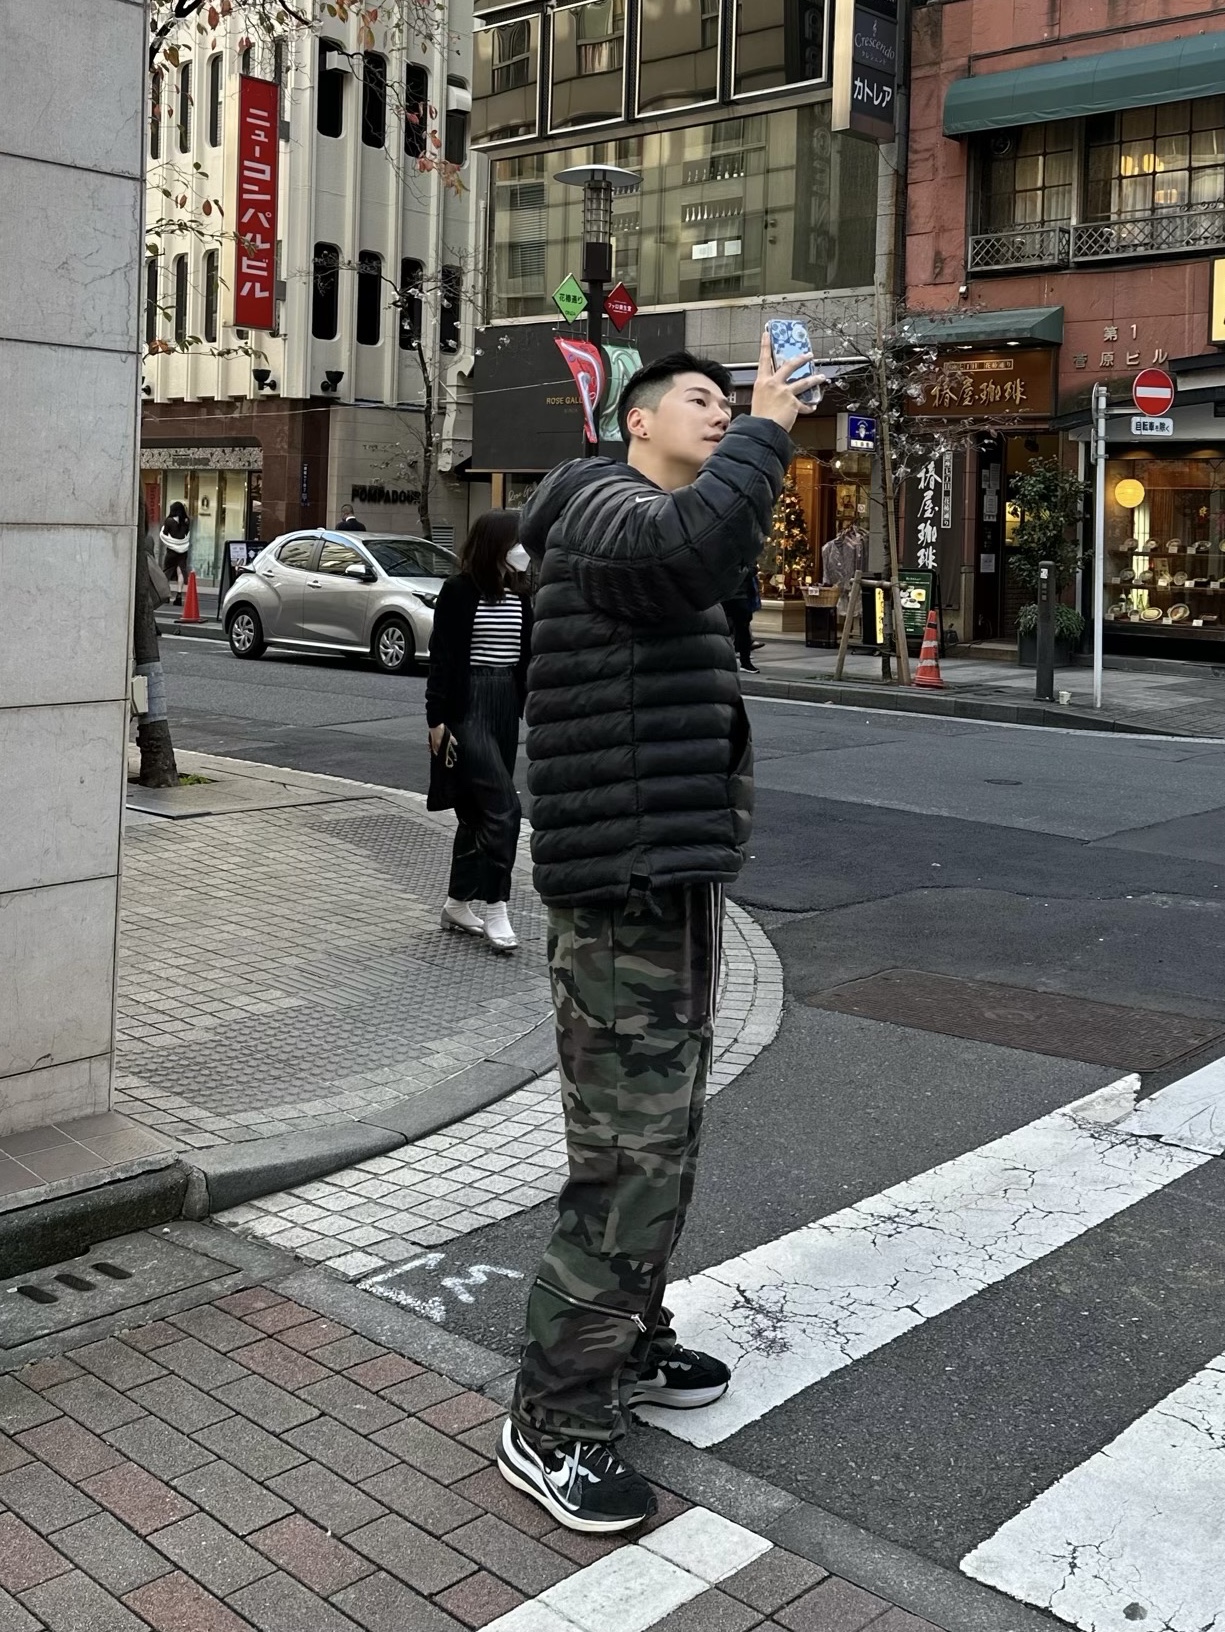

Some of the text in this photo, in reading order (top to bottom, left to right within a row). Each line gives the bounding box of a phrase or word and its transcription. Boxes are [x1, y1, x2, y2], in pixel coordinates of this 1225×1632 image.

[855, 32, 896, 60] Crescendo
[853, 76, 892, 108] カトレア
[1073, 348, 1168, 369] 菅原ビル
[546, 396, 584, 405] ROSE GALL
[1135, 421, 1170, 433] 自転車を除く
